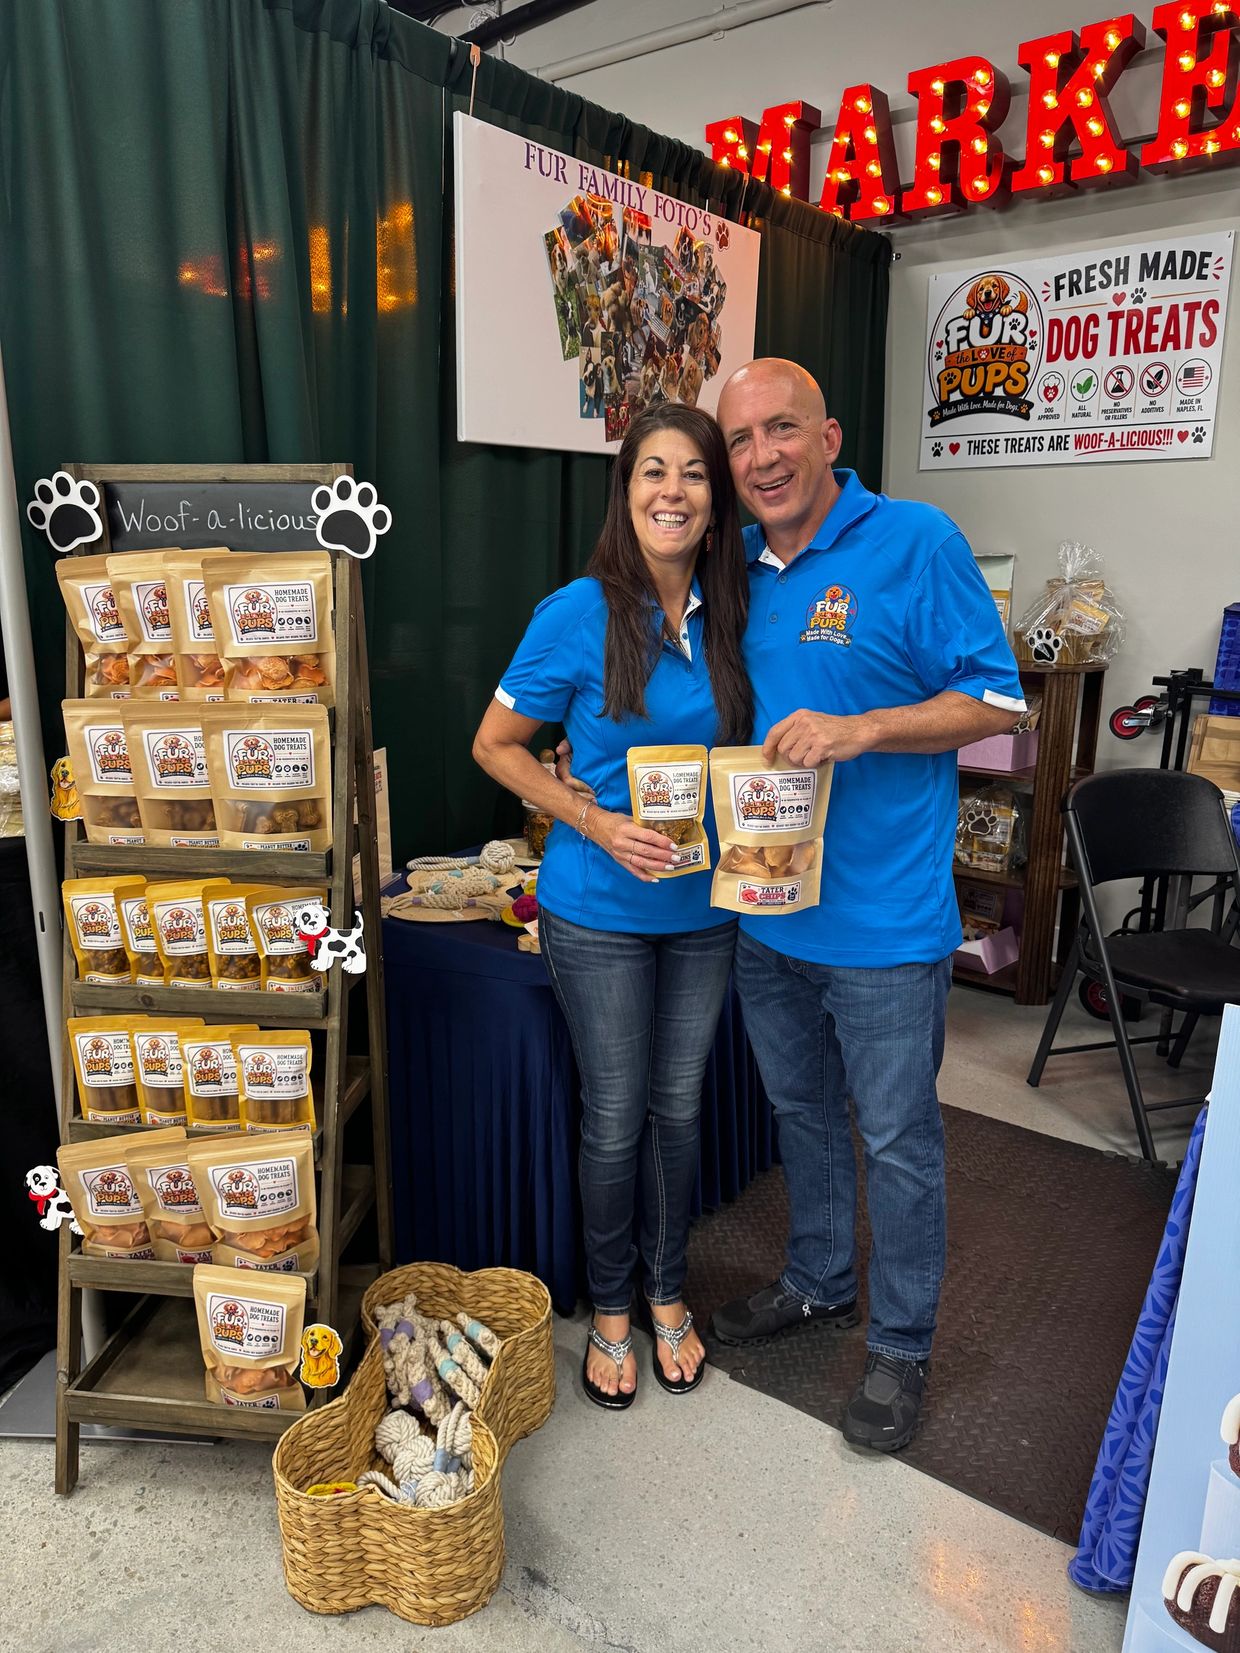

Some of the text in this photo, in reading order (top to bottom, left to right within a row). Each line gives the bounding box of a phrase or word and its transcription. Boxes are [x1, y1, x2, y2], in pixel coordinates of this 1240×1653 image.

[524, 142, 711, 236] FUR FAMILY FOTO'S
[1054, 250, 1213, 302] FRESH MADE
[946, 312, 1028, 354] FUR
[1046, 299, 1220, 363] DOG TREATS
[955, 354, 970, 365] the
[1007, 347, 1017, 361] of
[938, 361, 1030, 402] PUPS
[943, 407, 957, 417] Made
[957, 403, 970, 412] With
[982, 401, 997, 409] Made
[997, 401, 1005, 410] for
[1101, 407, 1132, 415] PRESERVATIVES
[1176, 405, 1197, 413] NAPLES,
[1037, 413, 1060, 421] APPROVED
[967, 428, 1174, 456] THESE TREATS ARE WOOF-A-LICIOUS!!!
[274, 588, 308, 596] HOMEMADE
[288, 595, 309, 603] TREATS
[96, 598, 117, 614] FU
[147, 598, 169, 613] FU
[238, 601, 272, 615] FUR
[815, 601, 849, 615] FUR
[238, 618, 274, 630] PUPS
[810, 617, 847, 631] PUPS
[820, 628, 833, 636] With
[286, 743, 307, 751] TREATS
[157, 747, 190, 760] FUR
[237, 749, 269, 761] FUR
[158, 764, 192, 774] PUPS
[236, 764, 270, 776] PUPS
[779, 777, 812, 785] HOMEMADE
[644, 782, 669, 793] FUR
[779, 783, 811, 792] DOG TREATS
[643, 795, 669, 804] PUPS
[743, 790, 775, 803] FUR
[742, 806, 776, 817] PUPS
[761, 886, 784, 894] TATER
[80, 913, 108, 923] FUR
[165, 918, 192, 929] FUR
[220, 916, 246, 927] FUR
[265, 917, 289, 928] FUR
[82, 925, 109, 934] PUPS
[221, 930, 247, 940] PUPS
[267, 929, 292, 940] PUPS
[165, 931, 194, 940] PUPS
[86, 1048, 110, 1060] FUR
[144, 1049, 167, 1060] FUR
[86, 1062, 112, 1072] PUPS
[144, 1062, 168, 1072] PUPS
[195, 1059, 219, 1070] FUR
[247, 1064, 272, 1074] FUR
[195, 1072, 221, 1082] PUPS
[247, 1076, 273, 1085] PUPS
[257, 1164, 290, 1175] HOMEMADE
[270, 1171, 291, 1180] TREATS
[94, 1182, 127, 1193] FUR
[161, 1181, 194, 1192] FUR
[222, 1180, 254, 1193] FUR
[96, 1193, 129, 1203] PUPS
[162, 1193, 196, 1204] PUPS
[250, 1305, 280, 1317] HOMEMADE
[216, 1311, 245, 1327] FUR
[250, 1313, 279, 1323] DOG TREATS
[214, 1327, 244, 1340] PUPS
